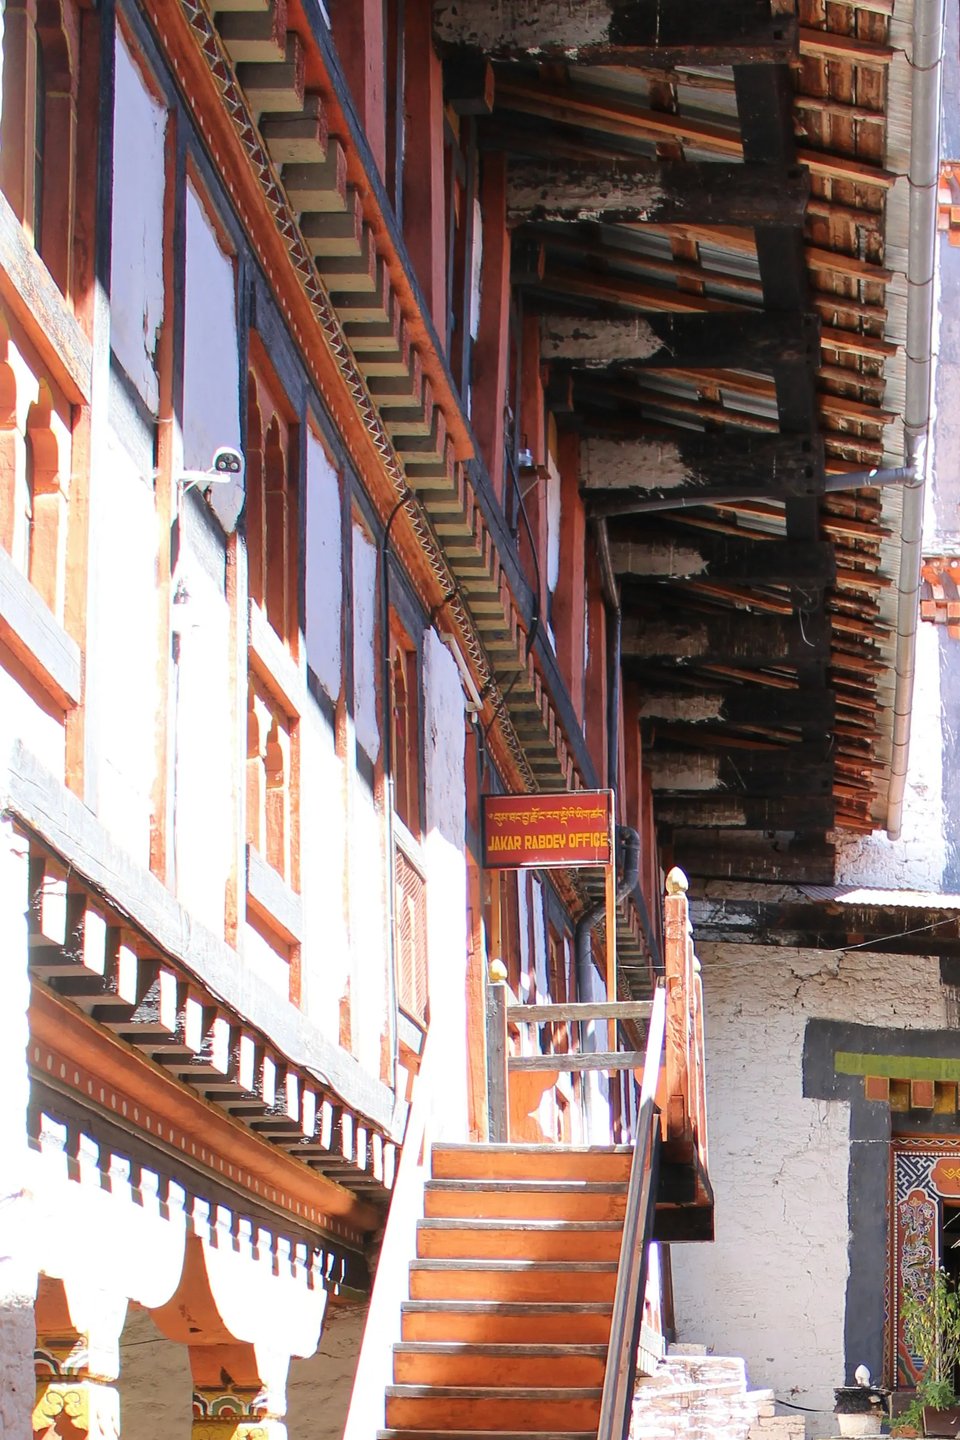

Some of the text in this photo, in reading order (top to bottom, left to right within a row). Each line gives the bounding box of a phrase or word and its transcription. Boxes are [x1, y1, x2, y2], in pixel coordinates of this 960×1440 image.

[488, 832, 608, 851] JAKAR RABDEY OFFICE
